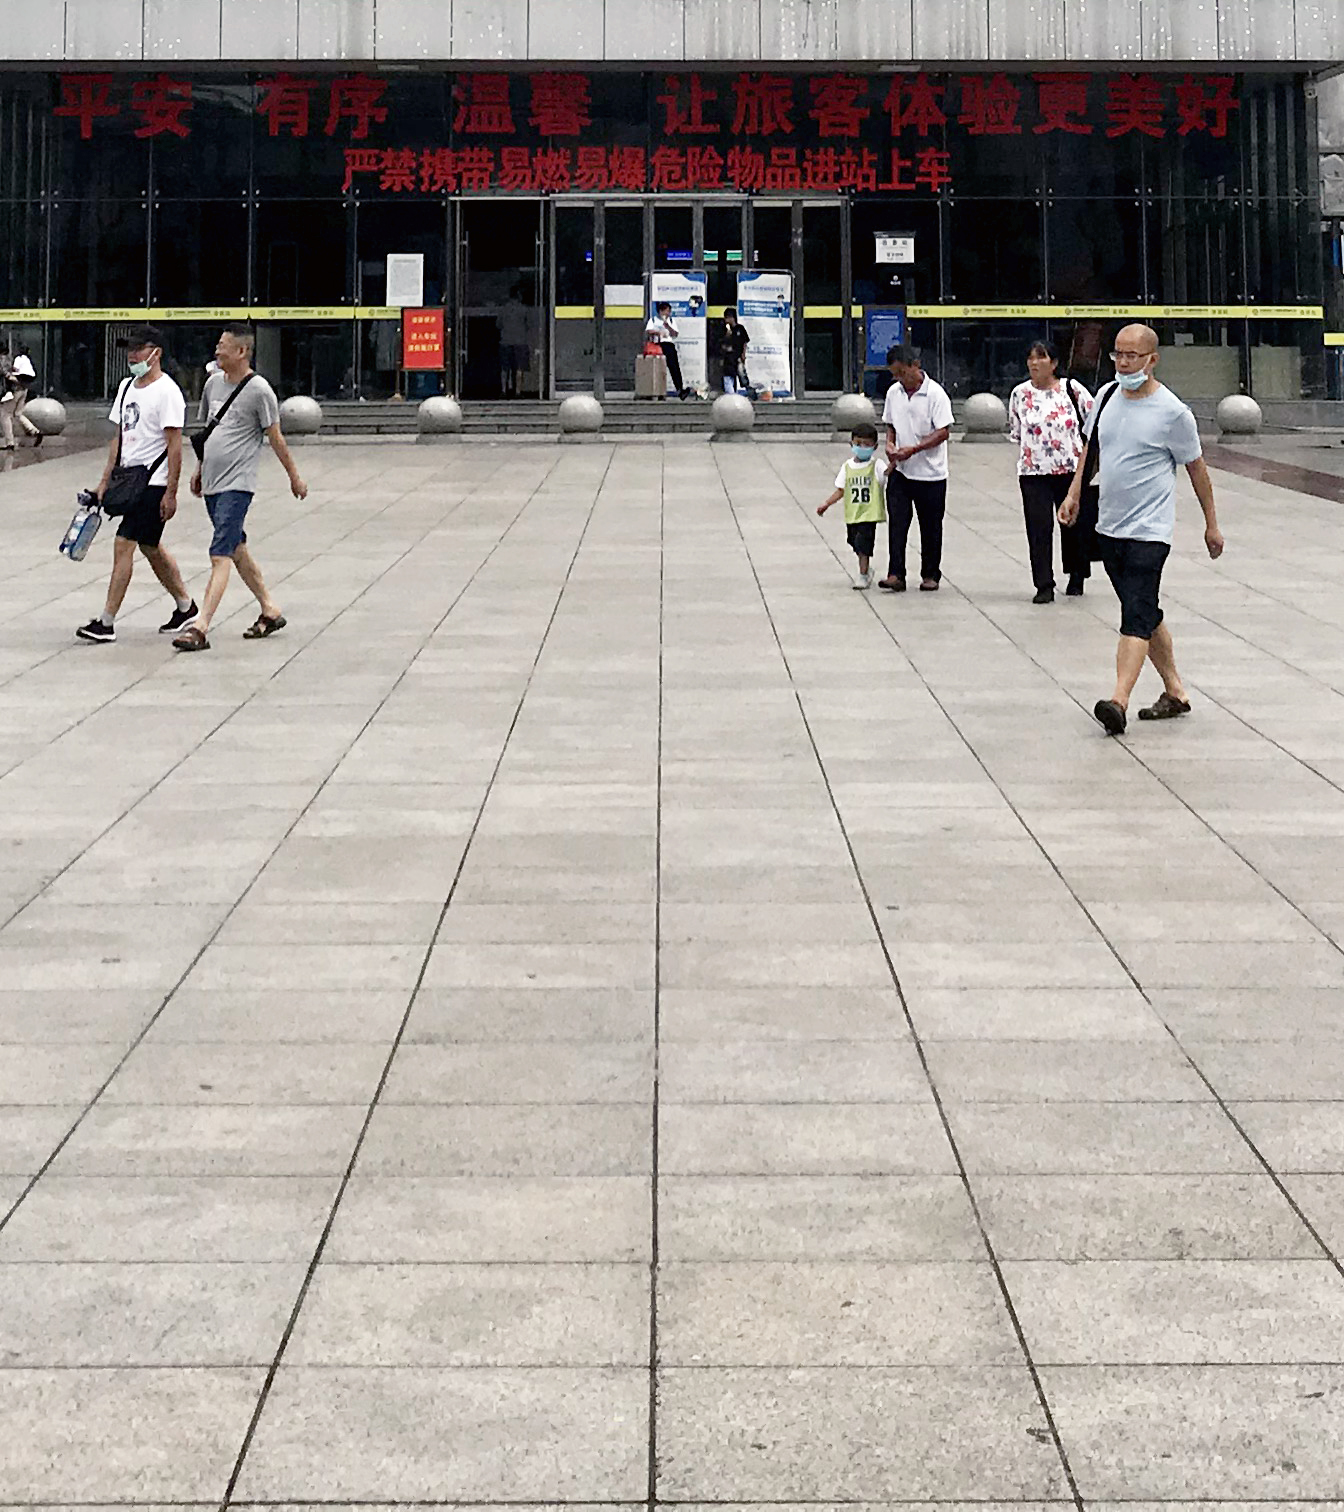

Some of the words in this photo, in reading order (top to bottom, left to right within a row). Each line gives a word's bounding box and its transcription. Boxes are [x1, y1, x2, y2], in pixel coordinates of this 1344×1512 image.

[52, 73, 194, 139] 平安
[256, 71, 389, 139] 有序
[452, 73, 593, 136] 温馨
[657, 71, 1241, 138] 让旅客体验更美好
[341, 142, 953, 193] 严禁携带易燃易爆危险物品进站上车
